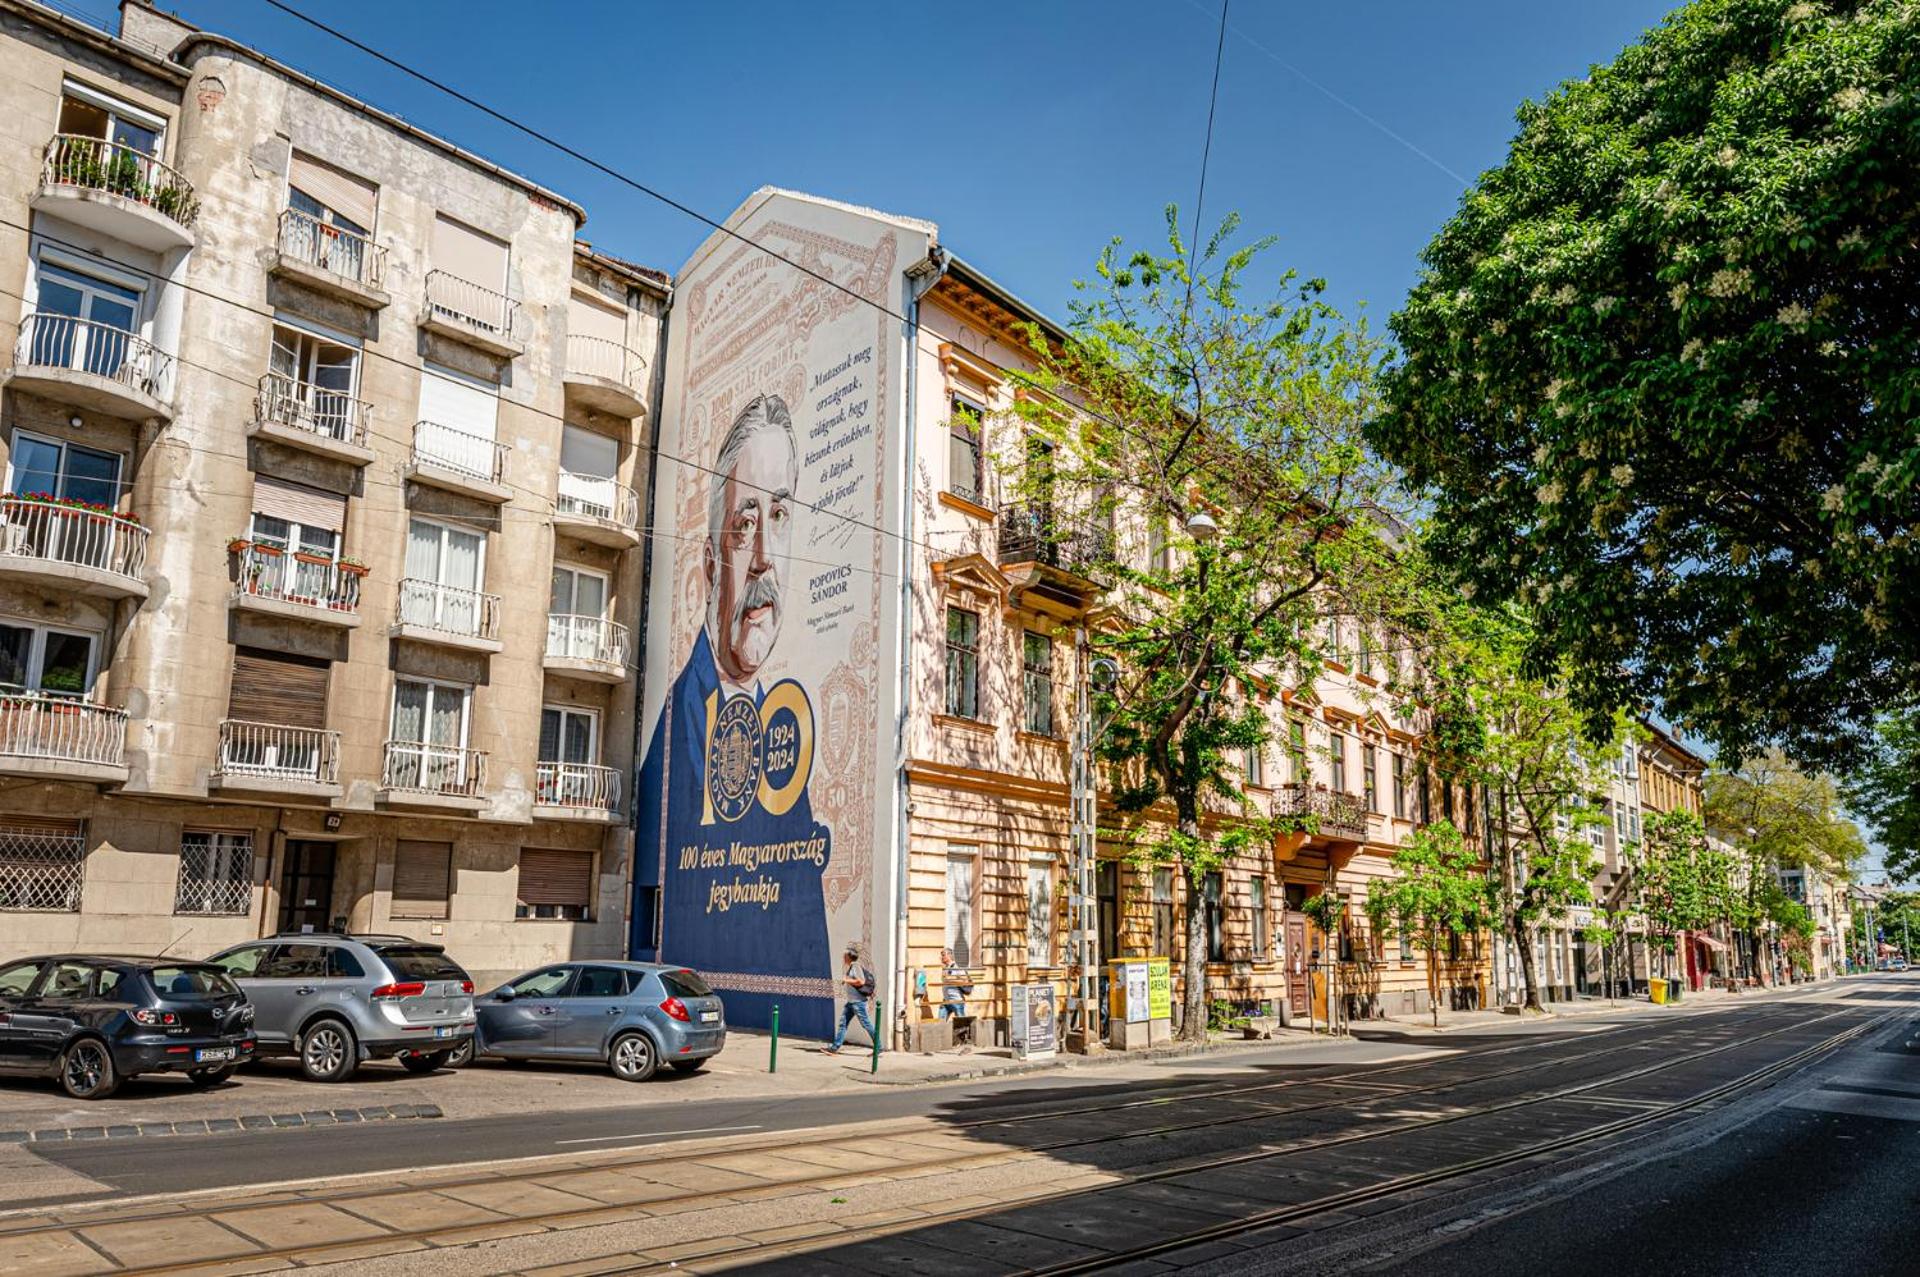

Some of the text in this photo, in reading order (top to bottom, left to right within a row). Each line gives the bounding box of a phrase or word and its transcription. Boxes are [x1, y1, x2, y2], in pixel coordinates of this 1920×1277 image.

[848, 399, 869, 419] hogy
[809, 563, 852, 591] POPOVICS
[768, 721, 796, 749] 1924
[767, 746, 795, 773] 2024
[679, 831, 827, 872] 100 éves Magyarország
[706, 874, 781, 914] jegybankja
